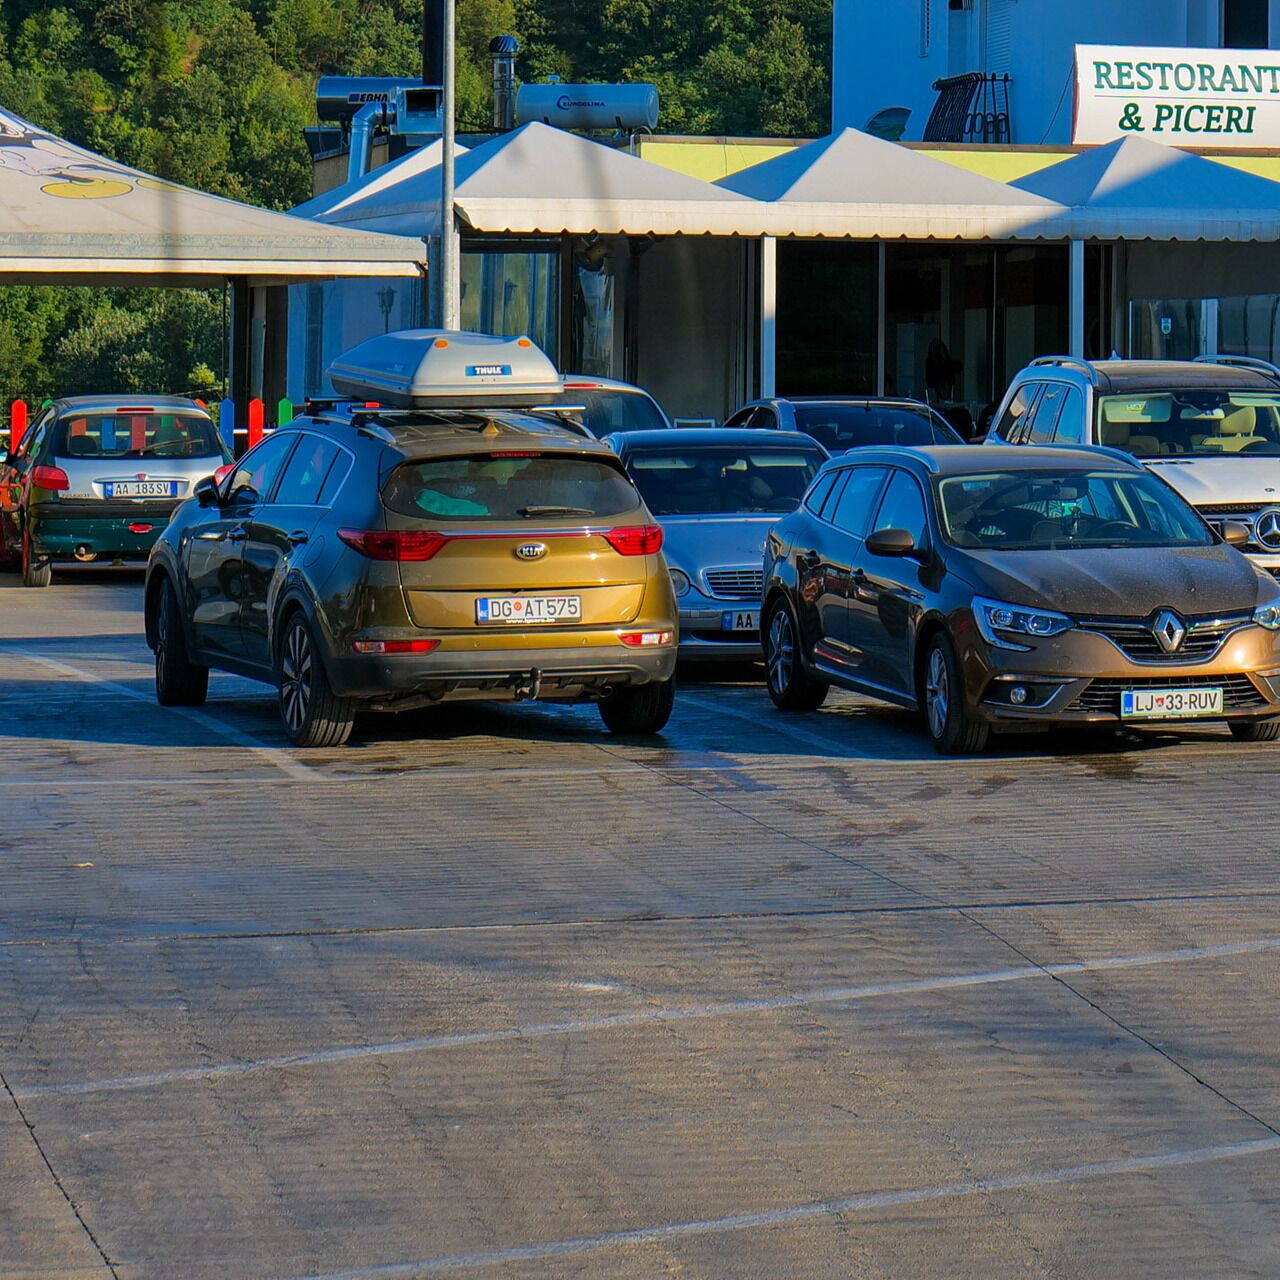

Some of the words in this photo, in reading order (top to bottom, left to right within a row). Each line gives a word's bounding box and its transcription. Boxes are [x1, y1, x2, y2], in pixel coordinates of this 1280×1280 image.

[1118, 102, 1145, 132] &
[1152, 104, 1257, 134] PICERI
[474, 366, 503, 375] THULE
[115, 484, 129, 495] AA
[522, 546, 545, 556] KIA
[491, 600, 512, 618] DG
[736, 613, 753, 628] AA
[1135, 695, 1154, 712] LJ
